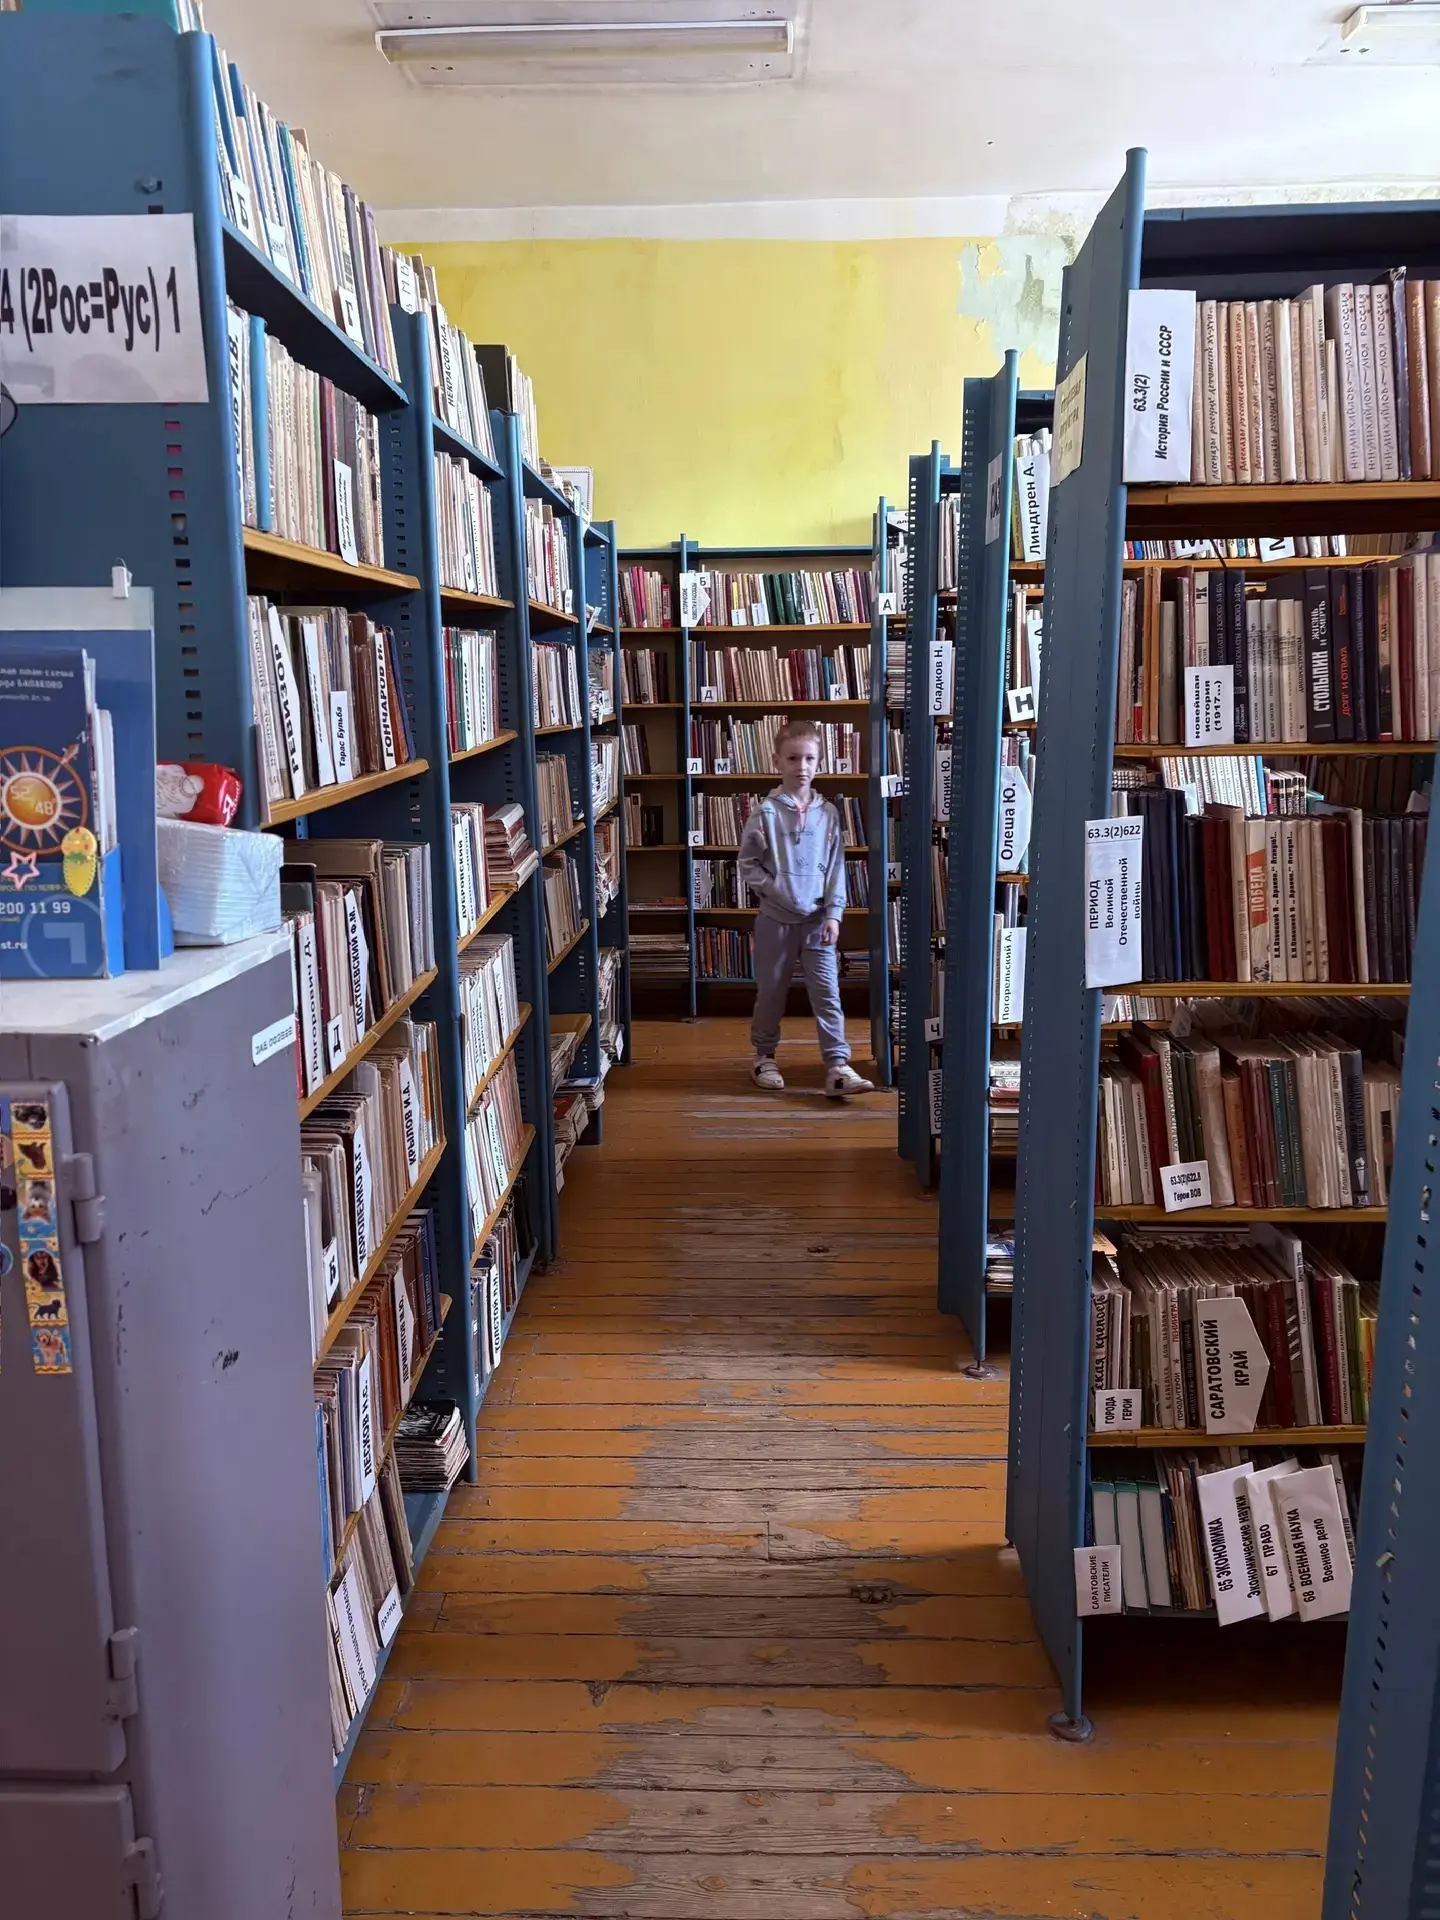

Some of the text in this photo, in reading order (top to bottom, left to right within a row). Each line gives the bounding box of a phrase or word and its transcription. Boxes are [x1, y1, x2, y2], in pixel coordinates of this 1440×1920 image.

[21, 266, 181, 352] (2Рос=Рус) 1
[1341, 291, 1350, 336] РОССИЯ
[1159, 325, 1173, 358] СССР
[443, 349, 456, 407] НЕКРАСОВ
[1134, 373, 1151, 412] 63.3(2)
[1156, 366, 1171, 407] России
[1154, 409, 1169, 460] История
[1028, 461, 1041, 555] Линдгрен А.
[700, 577, 706, 587] Б
[882, 599, 892, 611] А
[1311, 607, 1319, 640] ЖИЗНЬ
[1318, 600, 1327, 635] СМЕРТЬ
[704, 690, 713, 700] Д
[834, 687, 842, 697] К
[933, 645, 943, 712] Сладков Н.
[1311, 650, 1330, 712] СТОЛЫПИН
[274, 643, 299, 774] РЕВИЗОР
[379, 666, 395, 758] ГОНЧАРОВ
[337, 706, 347, 768] Тарас Бульба
[690, 760, 699, 772] Л
[717, 761, 728, 772] М
[840, 761, 848, 772] Р
[941, 756, 951, 816] Сотник Ю.
[691, 833, 700, 844] С
[1001, 782, 1016, 861] Олеша Ю.
[1088, 824, 1141, 840] 63.3(2)622
[457, 840, 466, 919] ДУБРОВСКИЙ
[694, 867, 702, 905] ДЕТЕКТИВ
[888, 867, 896, 880] К
[1250, 865, 1264, 913] ПОБЕДА
[1089, 878, 1101, 930] ПЕРИОД
[1105, 877, 1114, 929] Великой
[1118, 857, 1128, 946] Отечественной
[349, 904, 364, 1025] ДОСТОЕВСКИЙ Ф.М.
[1002, 931, 1012, 1020] Погорельский А.
[304, 967, 319, 1083] Григорович
[402, 1080, 417, 1166] КРЫЛОВ И.А.
[934, 1073, 943, 1130] СБОРНИКИ
[355, 1175, 367, 1264] КОРОЛЕНКО
[1173, 1187, 1202, 1202] Герои ВОВ
[492, 1299, 501, 1354] ТОЛСТОЙ
[1093, 1294, 1108, 1350] крепость
[397, 1325, 409, 1385] ЛЕРМОНТОВ
[1200, 1319, 1225, 1420] САРАТОВСКИЙ
[1225, 1350, 1250, 1387] КРАЙ
[1104, 1396, 1115, 1424] ГОРОДА
[1122, 1398, 1133, 1421] ГЕРОИ
[360, 1412, 372, 1478] ЛЕСКОВ
[1235, 1495, 1261, 1599] Экономические науки
[1259, 1523, 1278, 1577] 67 ПРАВО
[1286, 1508, 1301, 1541] НАУКА
[1208, 1517, 1234, 1592] 65 ЭКОНОМИКА
[1292, 1541, 1313, 1588] ВОЕННАЯ
[1313, 1518, 1335, 1583] Военное дело
[342, 1580, 354, 1626] ВРЕМЕНИ
[1091, 1555, 1100, 1610] САРАТОВСКИЕ
[1103, 1561, 1112, 1603] ПИСАТЕЛИ
[1303, 1590, 1316, 1603] 68
[349, 1627, 363, 1665] НАШЕГО
[357, 1665, 371, 1696] ГЕРОЙ
